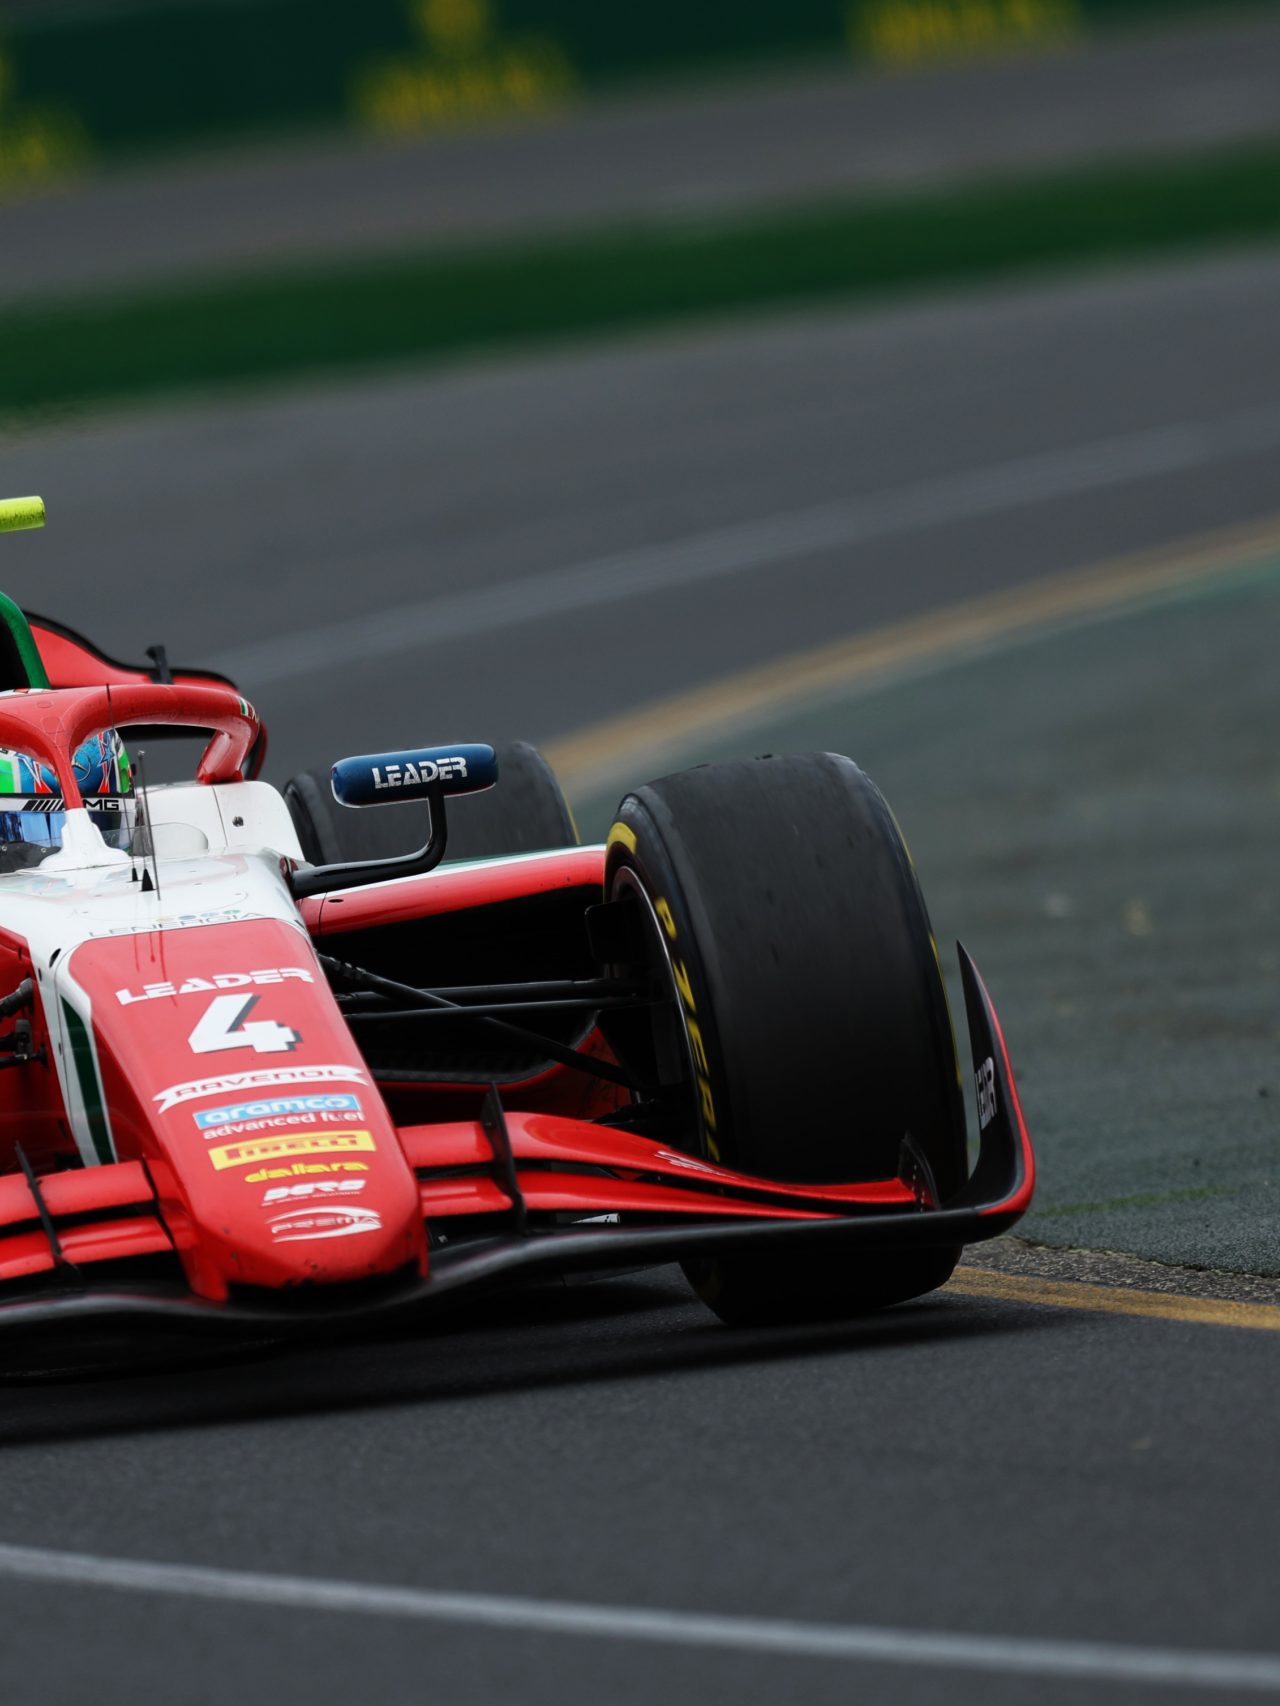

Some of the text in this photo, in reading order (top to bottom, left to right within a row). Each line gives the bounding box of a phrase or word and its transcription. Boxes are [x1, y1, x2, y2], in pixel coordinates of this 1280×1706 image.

[371, 756, 468, 789] LEADER
[84, 799, 119, 811] MG
[115, 967, 314, 1006] LEADER
[187, 992, 303, 1054] 4
[174, 1069, 347, 1098] RAVENOL
[204, 1097, 350, 1123] aramco
[203, 1113, 316, 1140] advanced
[244, 1162, 369, 1183] dallara
